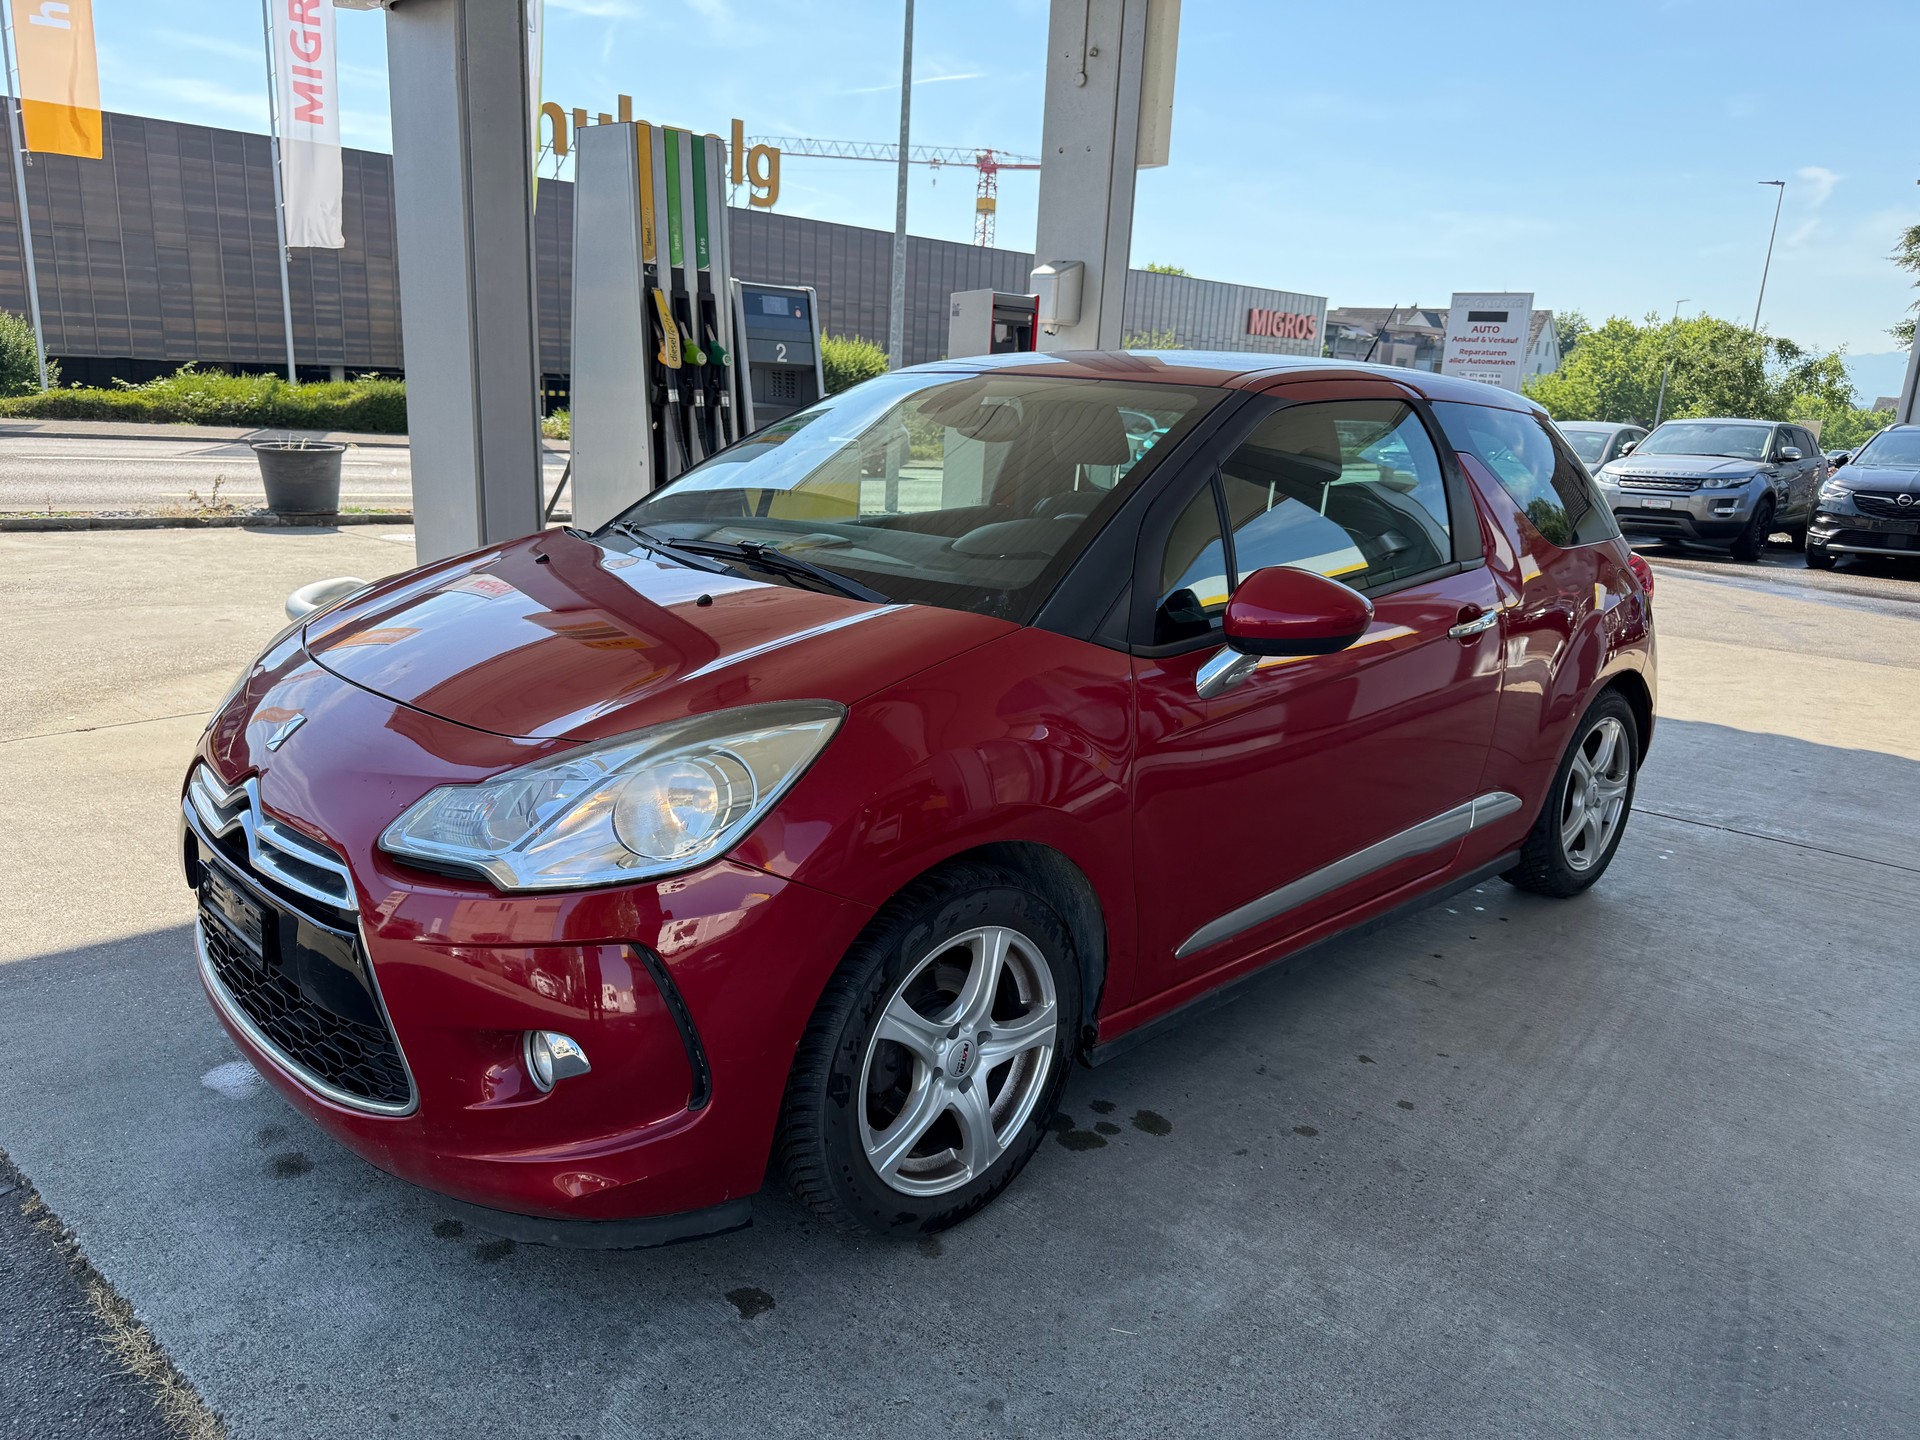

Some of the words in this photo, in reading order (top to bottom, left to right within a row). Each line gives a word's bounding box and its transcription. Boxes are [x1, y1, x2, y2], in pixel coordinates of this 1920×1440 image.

[1247, 308, 1318, 340] MIGROS
[1471, 325, 1500, 334] AUTO
[775, 343, 788, 363] 2
[1459, 348, 1507, 357] Reparaturen
[1467, 358, 1516, 366] Automarken
